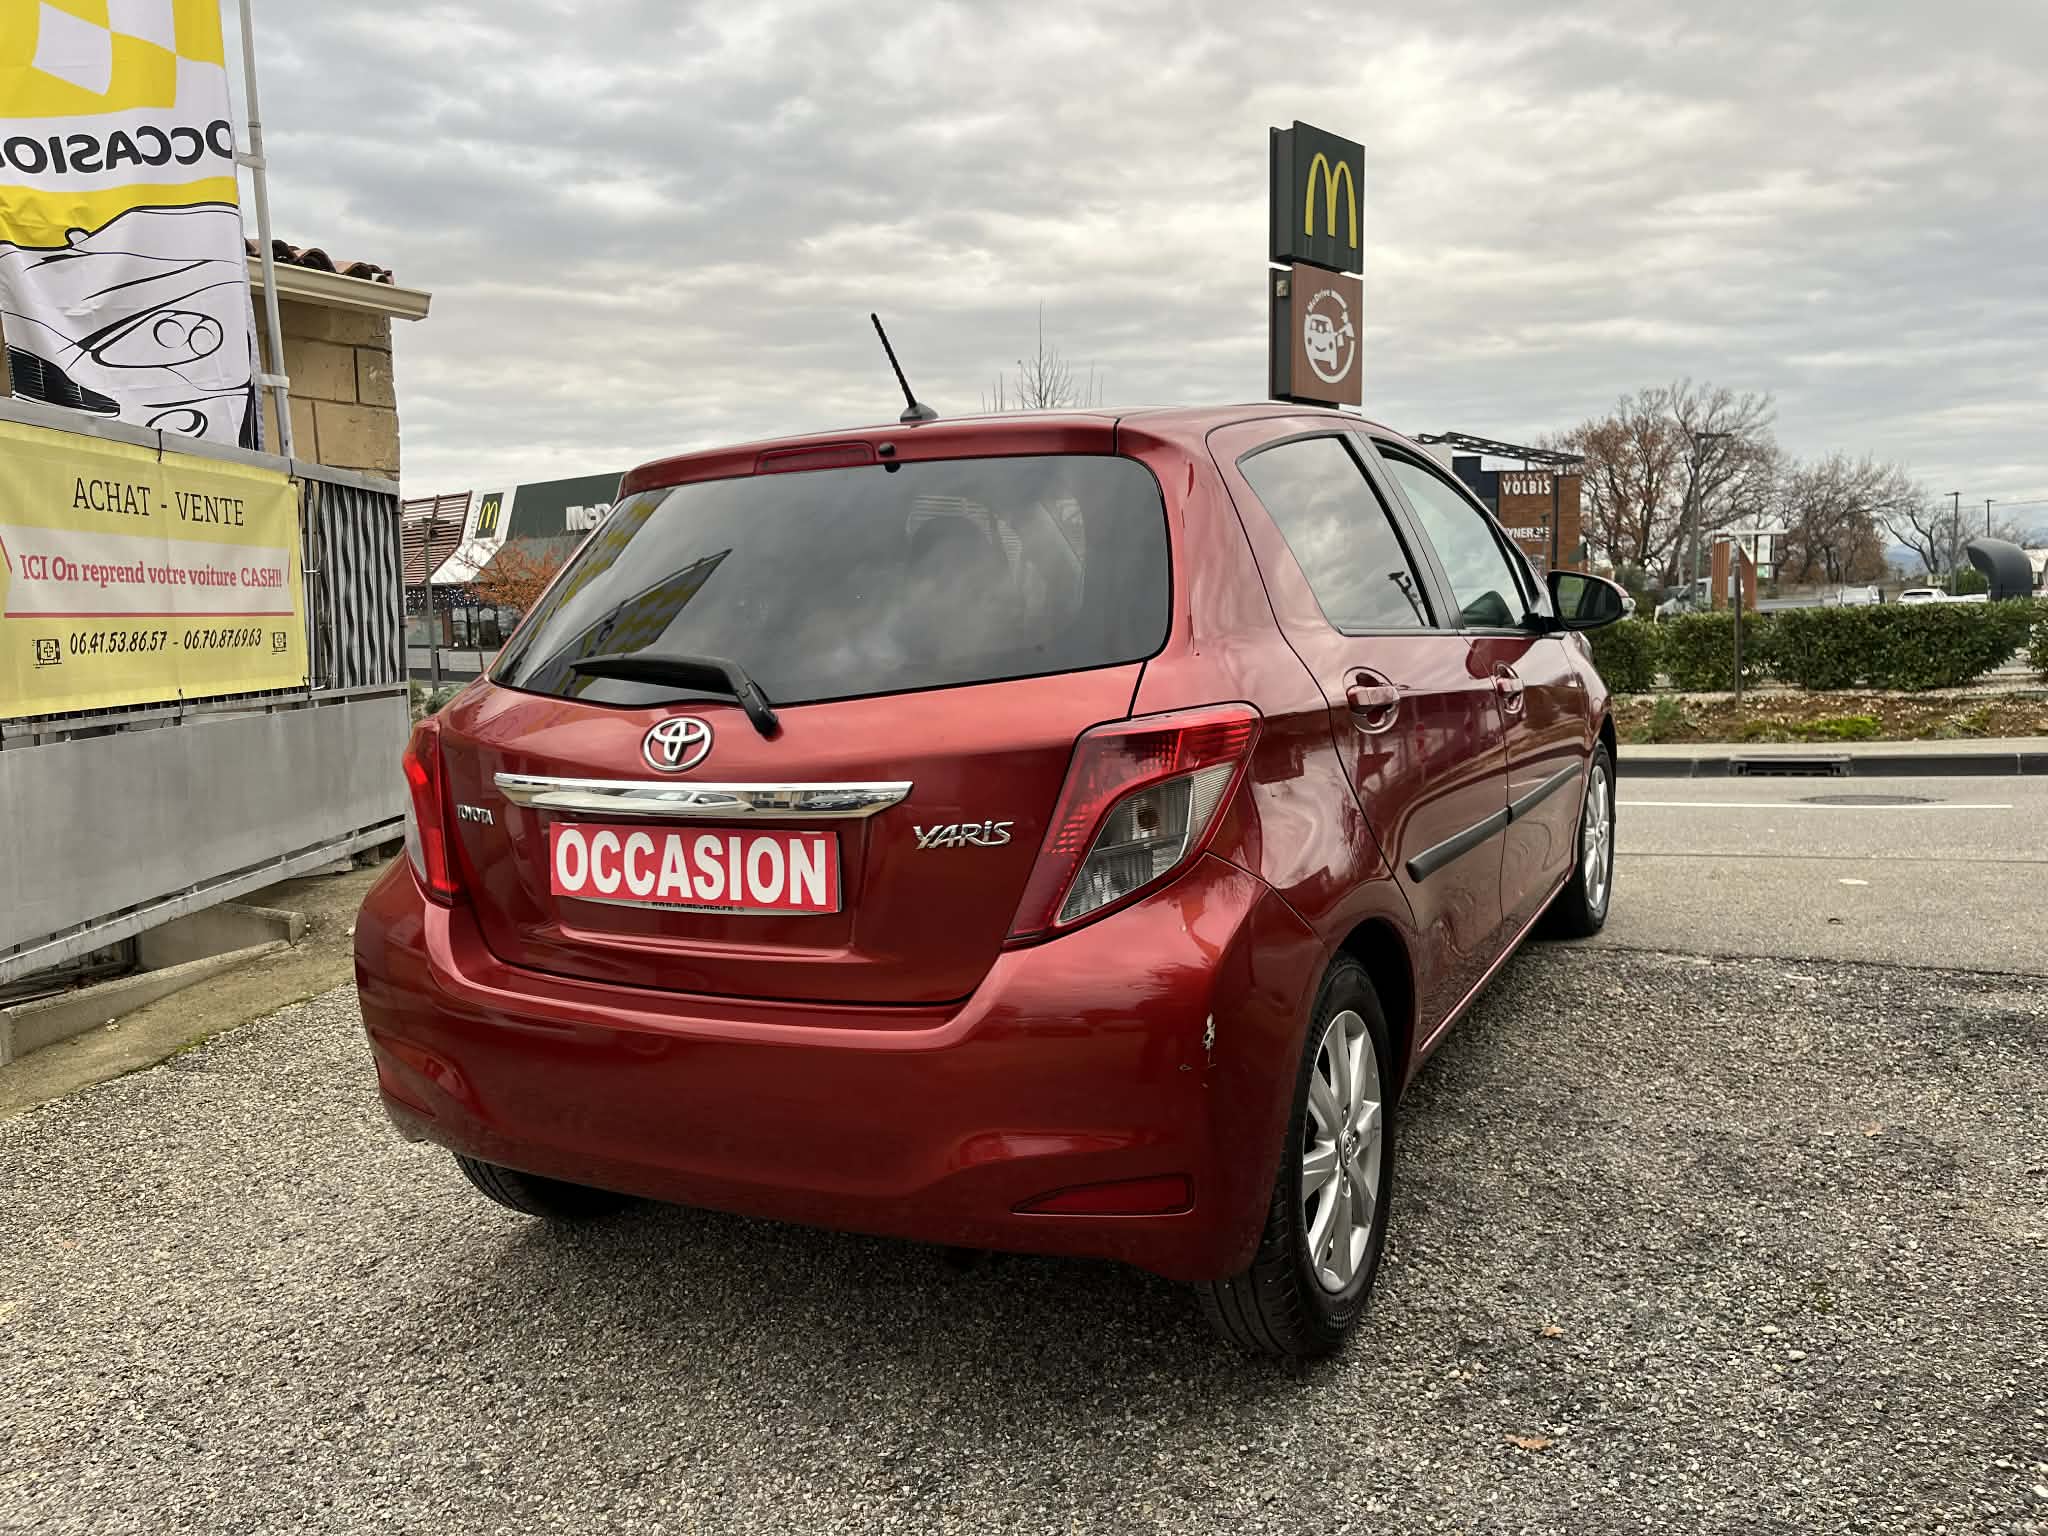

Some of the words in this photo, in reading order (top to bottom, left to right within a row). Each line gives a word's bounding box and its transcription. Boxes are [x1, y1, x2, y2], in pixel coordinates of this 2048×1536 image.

[73, 477, 151, 516] ACHAT
[174, 491, 245, 527] VENTE
[1502, 480, 1551, 496] VOLBIS
[19, 554, 48, 581] ICI
[52, 556, 79, 582] On
[82, 561, 145, 588] reprend
[148, 566, 186, 585] votre
[188, 564, 237, 587] voiture
[69, 630, 168, 655] 06.41.53.86.57
[183, 628, 263, 650] 06.70.87.69.63
[456, 804, 494, 825] TOYOTA
[556, 829, 827, 905] OCCASION
